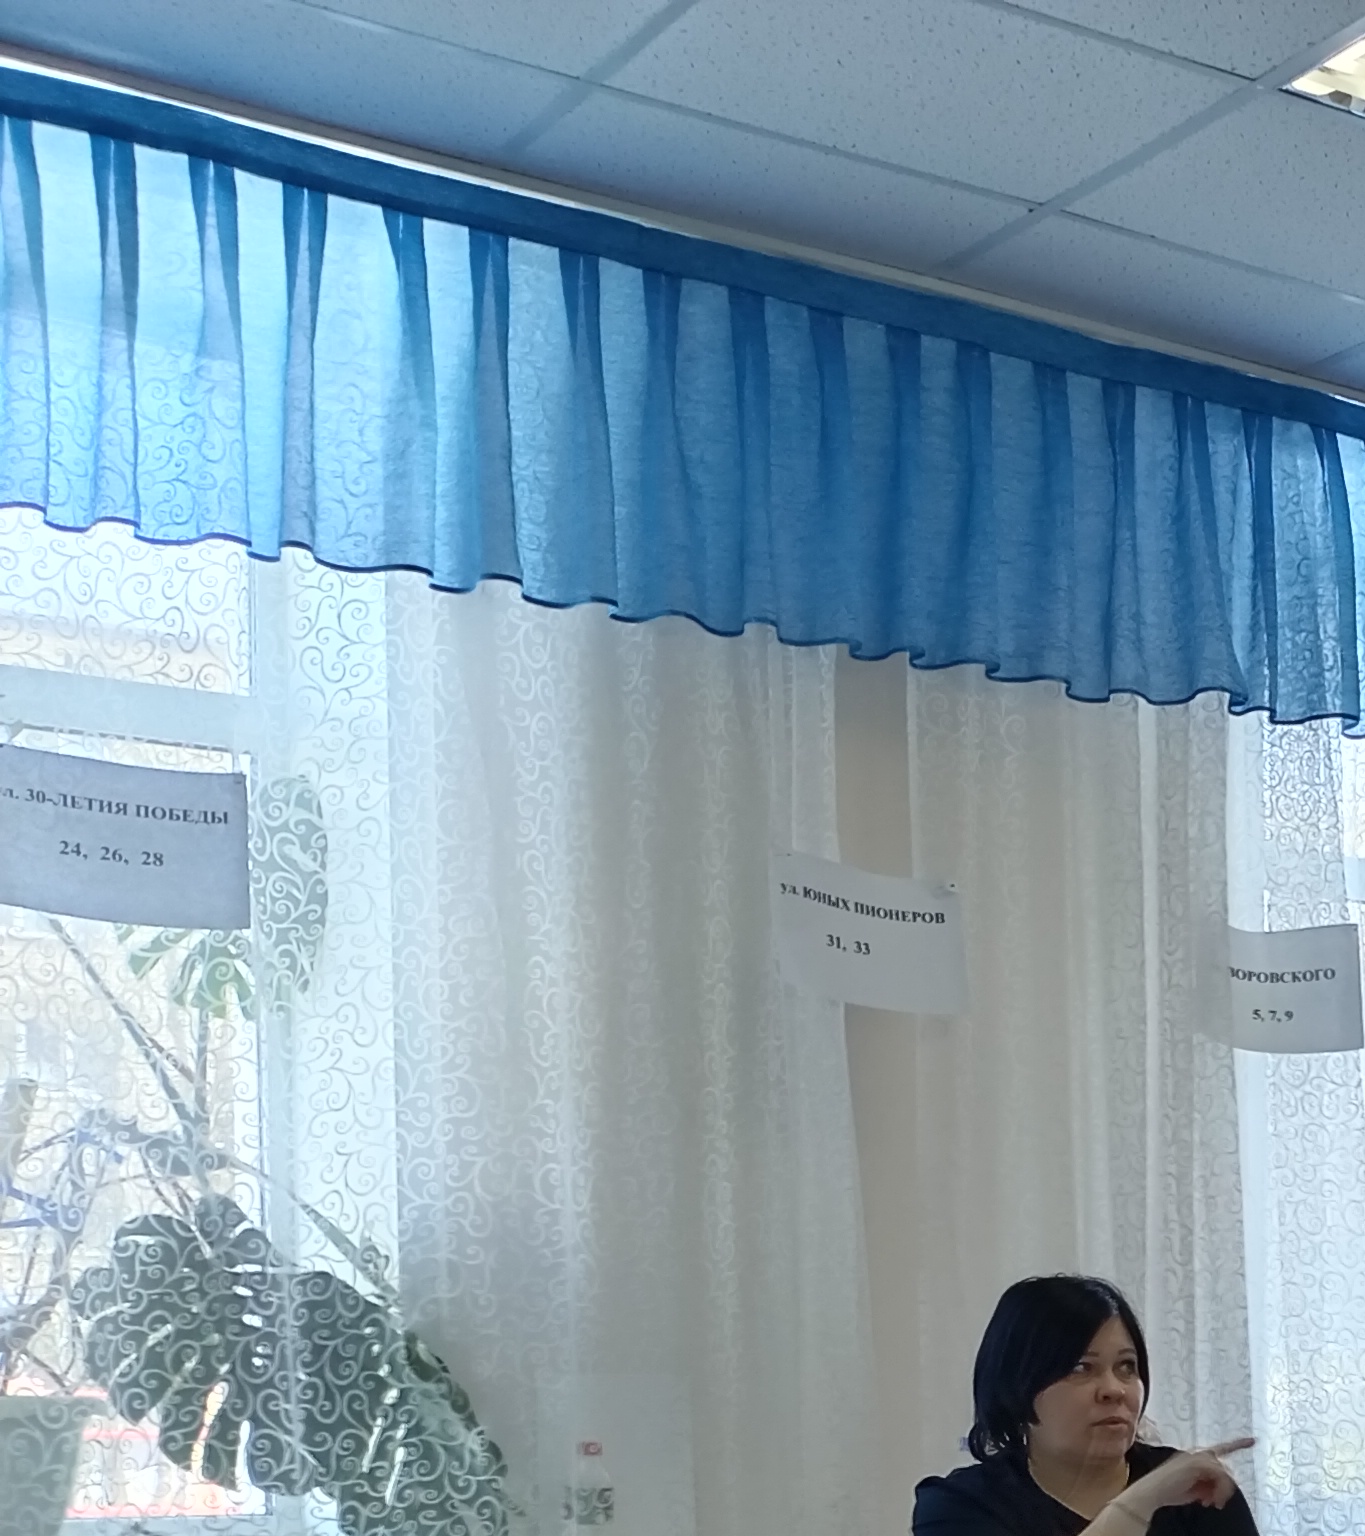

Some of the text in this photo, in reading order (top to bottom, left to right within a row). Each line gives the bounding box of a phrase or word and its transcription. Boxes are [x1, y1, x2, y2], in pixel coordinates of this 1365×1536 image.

[0, 786, 229, 825] л. 30-ЛЕТИЯ ПОБЕДЫ
[59, 840, 164, 867] 24, 26, 28
[803, 886, 851, 912] ЮНЫХ
[853, 902, 946, 924] ПИОНЕРОВ
[853, 941, 871, 956] 33
